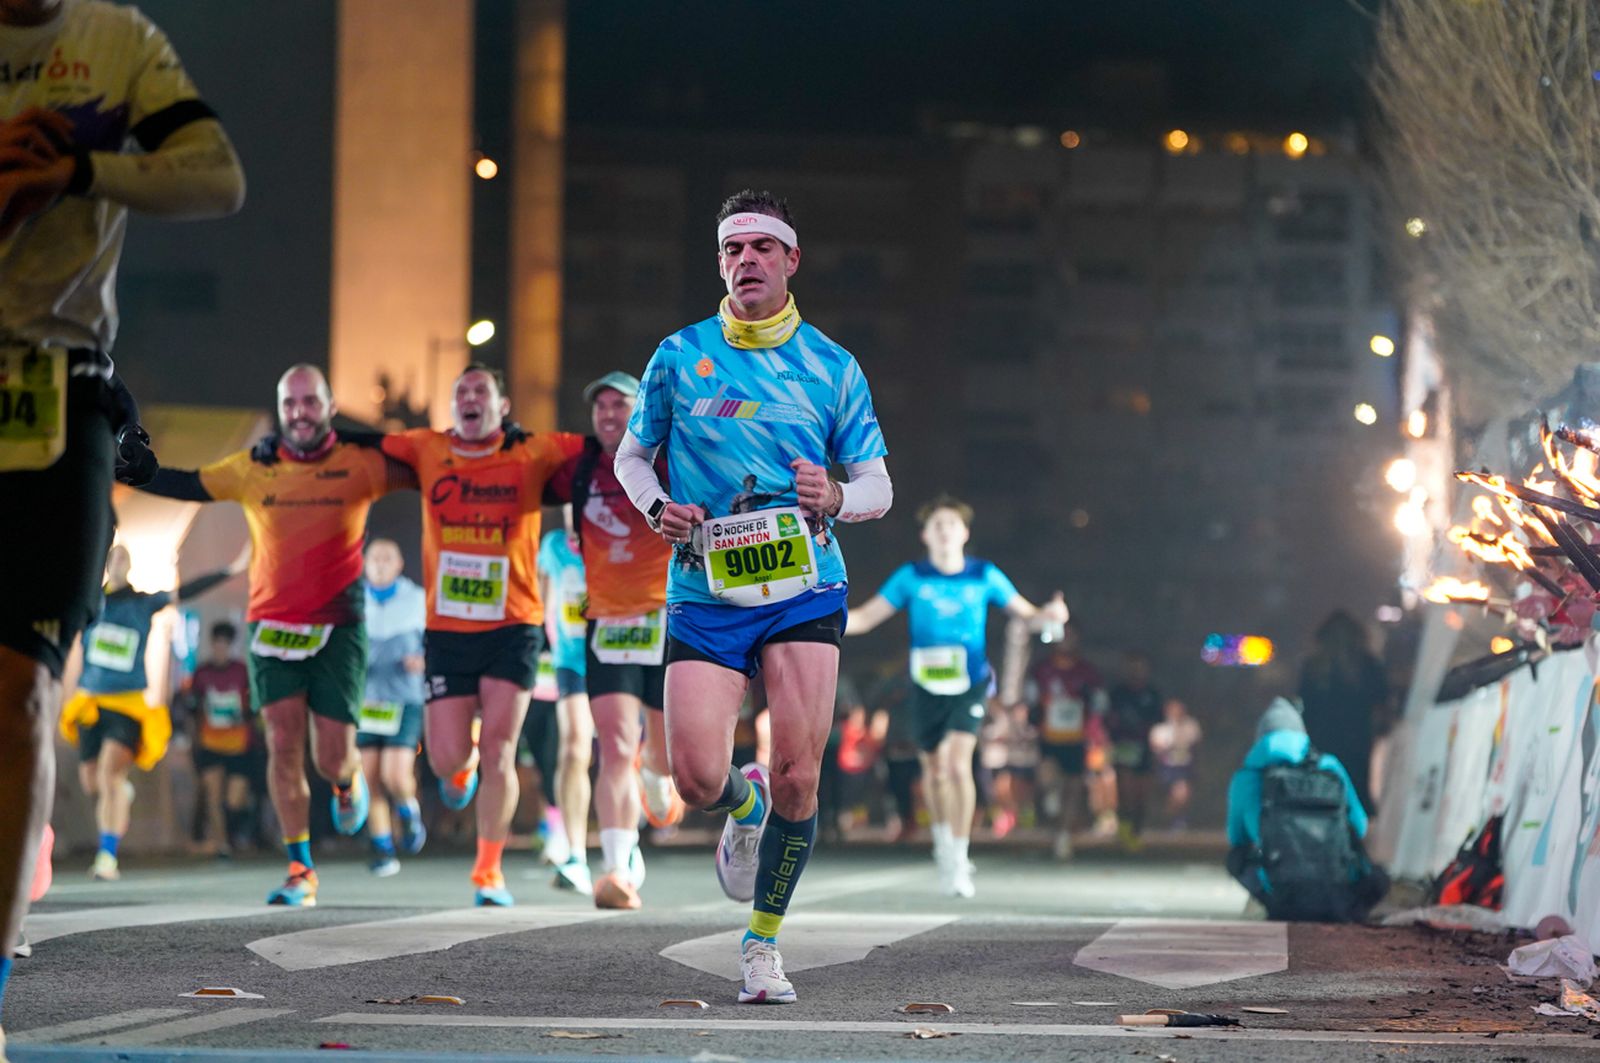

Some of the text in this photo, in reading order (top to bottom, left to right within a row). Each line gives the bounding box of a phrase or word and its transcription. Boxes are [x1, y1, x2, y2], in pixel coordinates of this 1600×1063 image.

[724, 522, 755, 536] NOCHE
[756, 520, 768, 531] DE
[714, 537, 735, 550] SAN
[736, 530, 771, 547] ANTÓN
[724, 540, 796, 577] 9002
[449, 577, 494, 598] 4425
